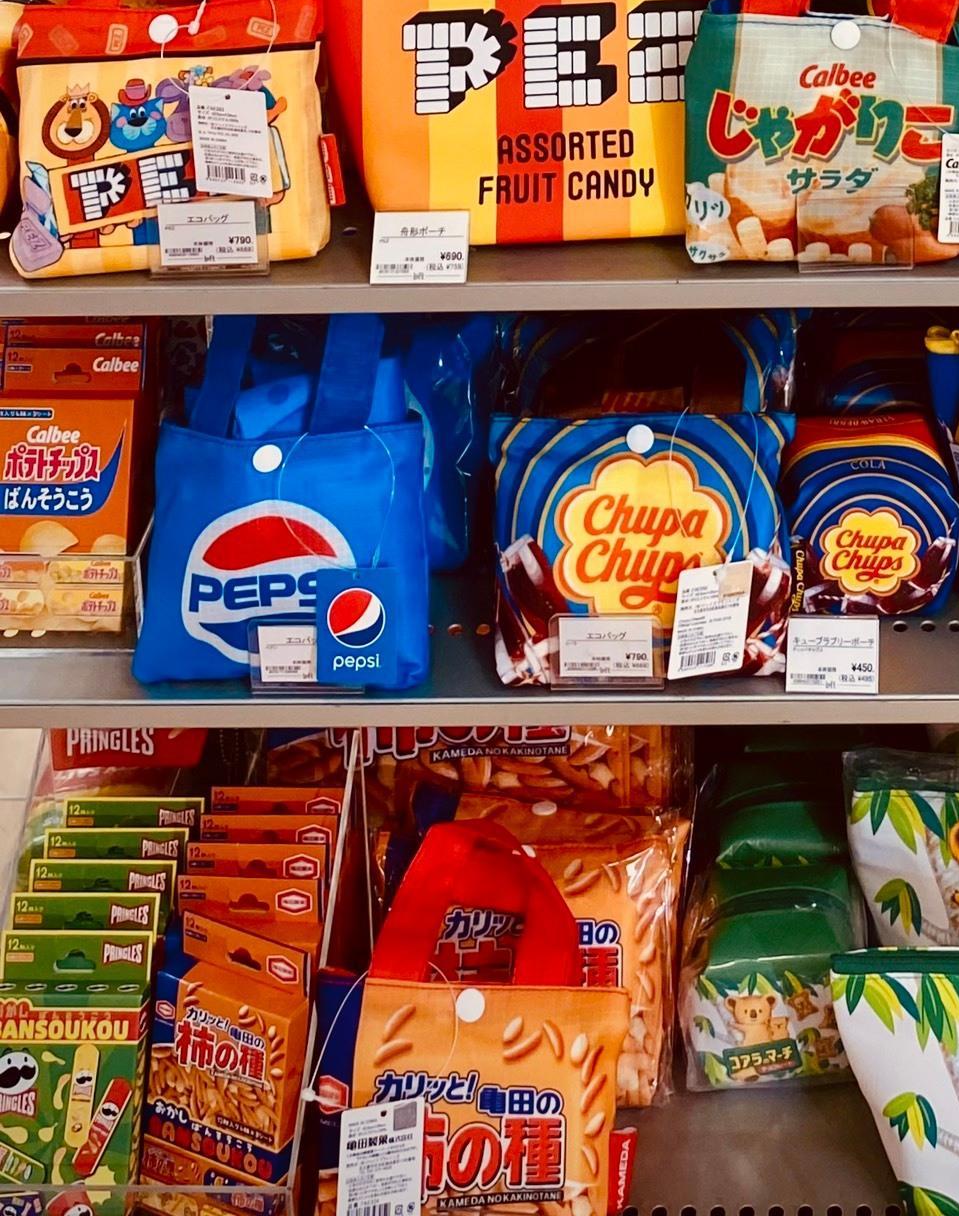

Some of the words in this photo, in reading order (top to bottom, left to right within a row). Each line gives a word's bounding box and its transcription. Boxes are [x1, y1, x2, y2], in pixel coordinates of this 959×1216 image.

[799, 63, 877, 89] Calbee
[706, 88, 955, 163] じゃがりこ
[498, 129, 634, 165] ASSORTED
[478, 172, 557, 205] FRUIT
[567, 168, 655, 200] CANDY
[787, 167, 879, 195] サラダ
[186, 214, 230, 223] エコバッグ
[229, 236, 251, 244] ¥790
[440, 252, 463, 261] ¥690
[92, 357, 139, 372] Calbee
[27, 426, 80, 444] Calbee
[4, 442, 101, 482] ポテトチップス
[850, 459, 886, 471] COLA
[4, 486, 93, 511] ばんそうこう
[583, 494, 708, 548] Chupa
[836, 530, 907, 553] Chupa
[832, 549, 904, 581] Chups
[188, 572, 318, 613] PEPS
[586, 632, 627, 640] エコバッグ
[332, 653, 380, 671] pepsi
[625, 652, 648, 661] ¥790
[851, 663, 873, 672] ¥450
[433, 747, 483, 761] KAMEDA
[159, 809, 195, 826] PRINGLES
[142, 839, 179, 858] PRINGLES
[128, 872, 167, 891] PRINGLES
[110, 904, 149, 925] PRINGLES
[103, 943, 143, 965] PRINGLES
[175, 1020, 266, 1082] 柿の種
[478, 1086, 563, 1116] 亀田の
[154, 1101, 188, 1124] おかし
[616, 1140, 632, 1210] KAMEDA
[439, 1194, 484, 1210] KAMEDA
